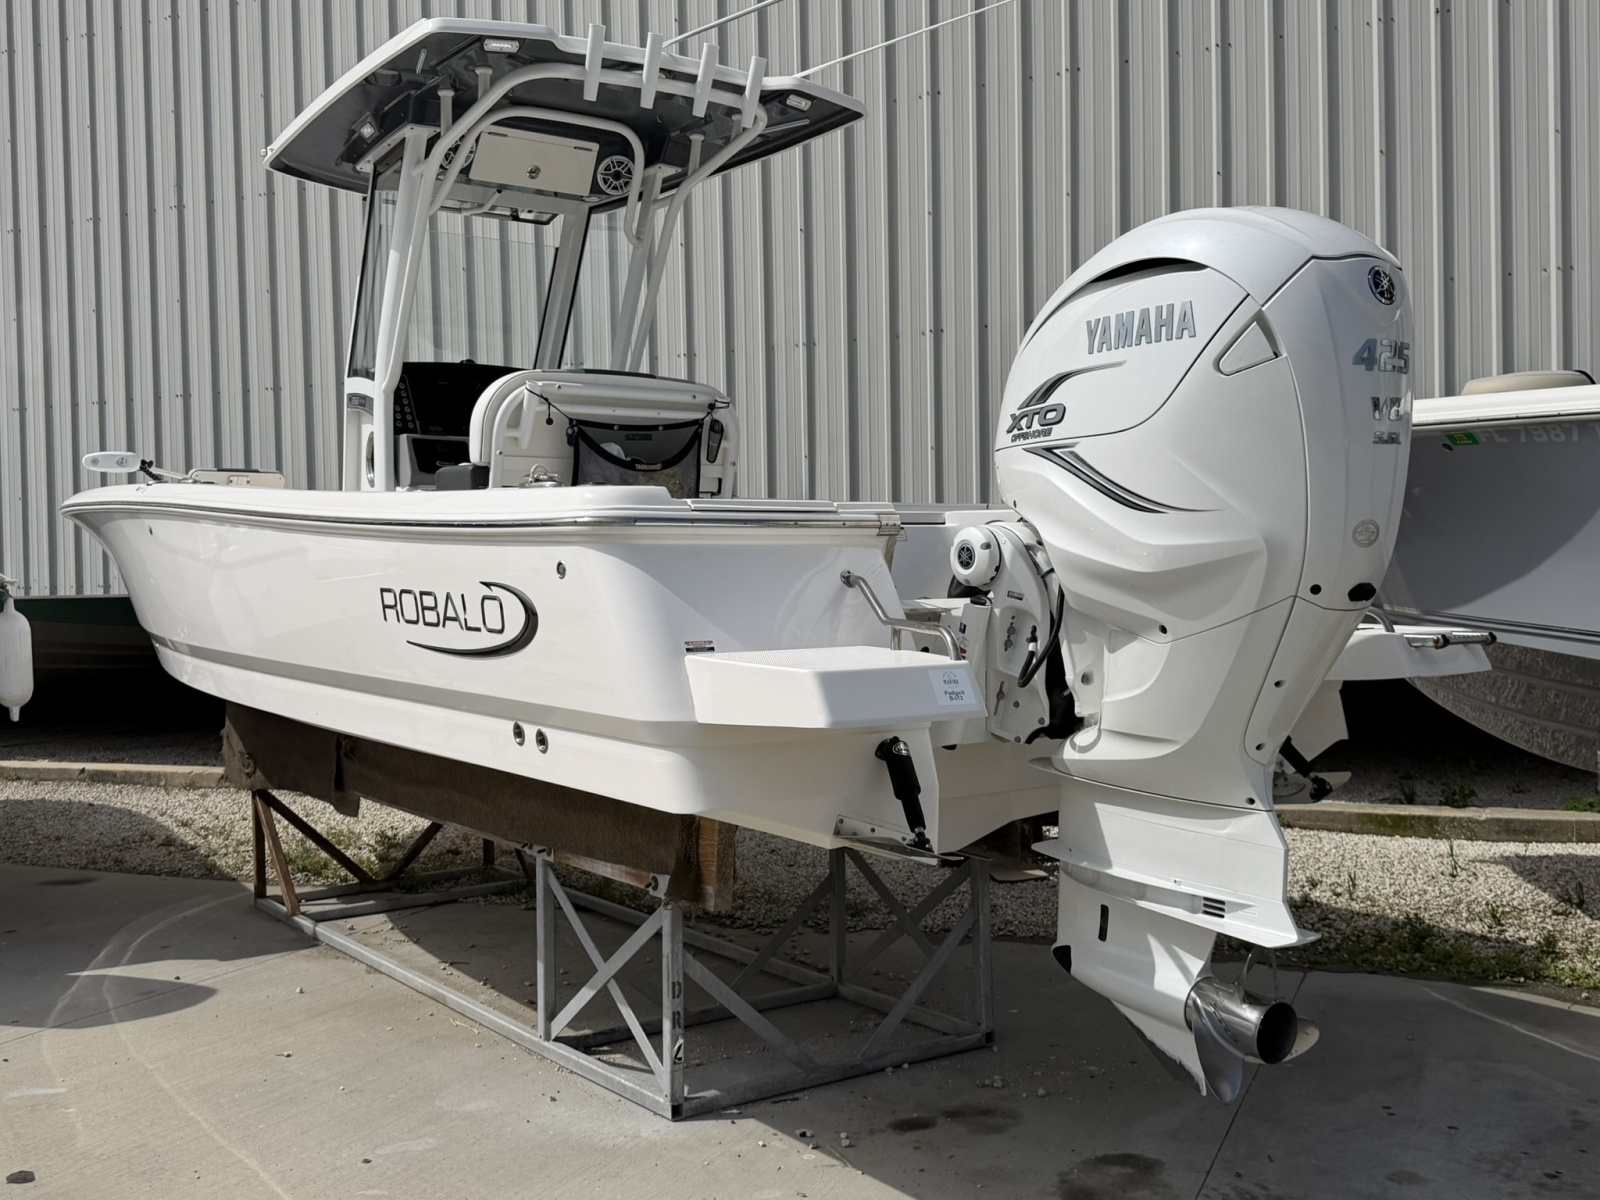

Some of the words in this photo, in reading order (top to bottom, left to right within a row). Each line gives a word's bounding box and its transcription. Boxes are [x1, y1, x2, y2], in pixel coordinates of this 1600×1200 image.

[1085, 299, 1197, 355] YAMAHA
[1352, 337, 1410, 375] 425
[1006, 402, 1067, 434] XTO
[1370, 396, 1404, 421] V8
[1010, 427, 1053, 443] OFFSHORE
[1475, 428, 1509, 443] FL
[1511, 424, 1580, 443] 7987
[379, 587, 506, 635] ROBALO
